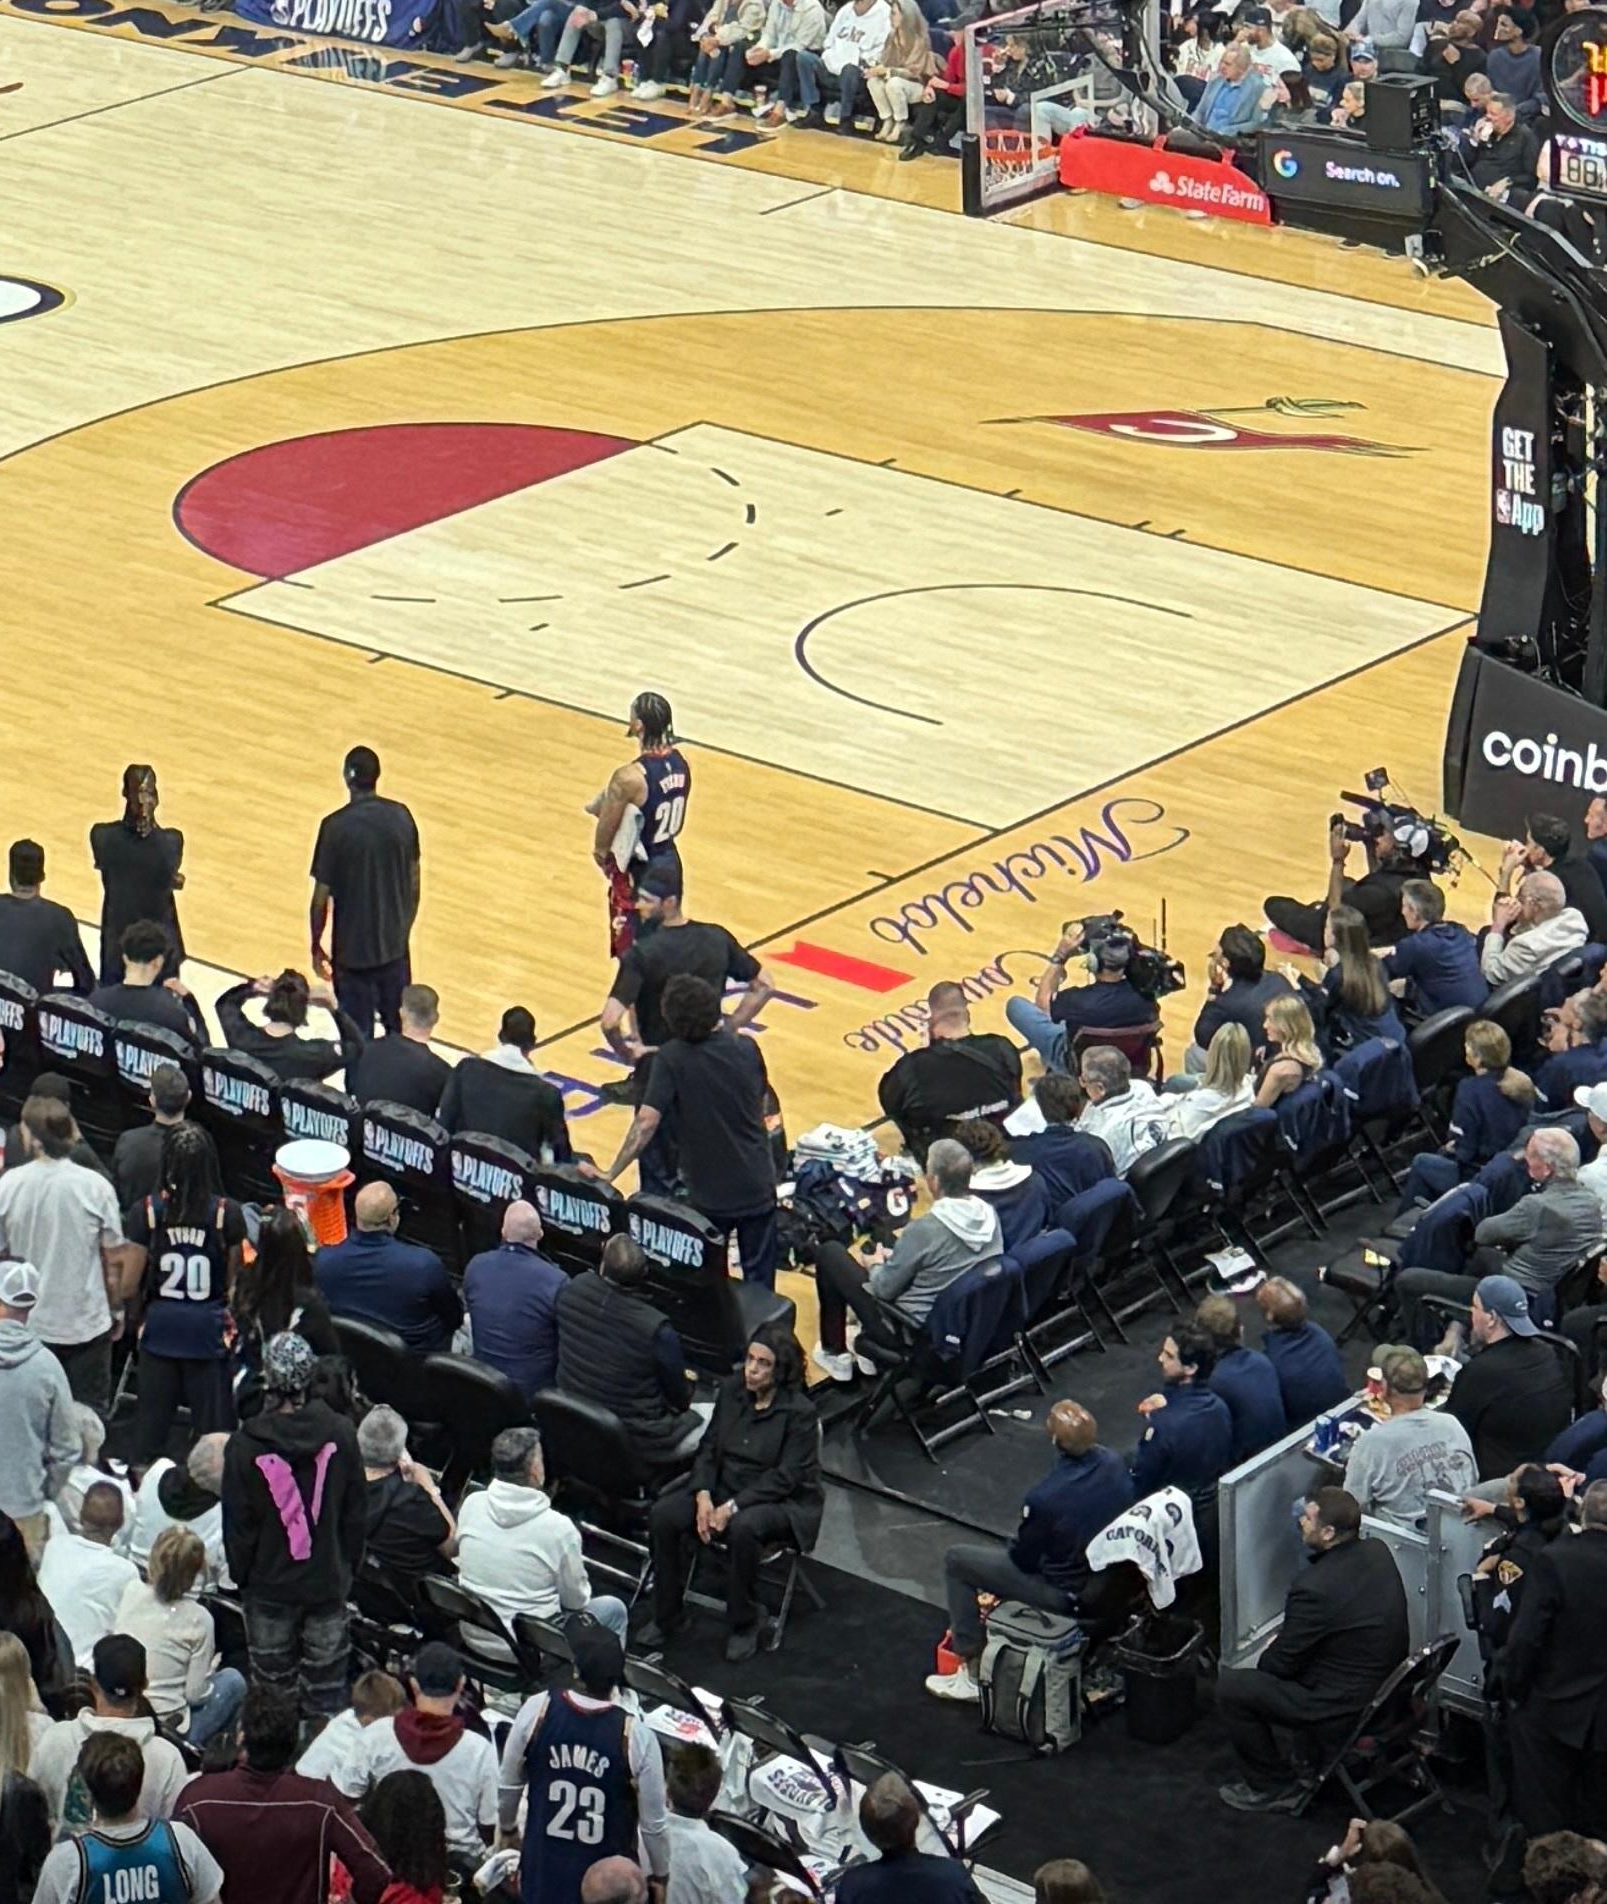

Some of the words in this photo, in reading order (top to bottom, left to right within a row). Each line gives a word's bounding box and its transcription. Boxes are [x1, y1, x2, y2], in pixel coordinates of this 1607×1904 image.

[1325, 161, 1375, 184] Search
[1501, 426, 1536, 463] GET
[1503, 458, 1536, 496] THE
[1511, 492, 1546, 537] App
[652, 795, 686, 845] 20
[869, 796, 1193, 957] Michelob
[48, 1013, 105, 1058] PLAYOFFS
[214, 1071, 271, 1117] PLAYOFFS
[292, 1102, 349, 1145] PLAYOFFS
[375, 1121, 435, 1175] PLAYOFFS
[462, 1154, 524, 1201] PLAYOFFS
[549, 1189, 612, 1234] PLAYOFFS
[165, 1221, 208, 1249] TYSON
[642, 1218, 704, 1269] PLAYOFFS
[158, 1252, 213, 1303] 20
[254, 1441, 339, 1561] V
[548, 1743, 611, 1779] JAMES
[546, 1779, 607, 1846] 23
[103, 1862, 160, 1903] LONG
